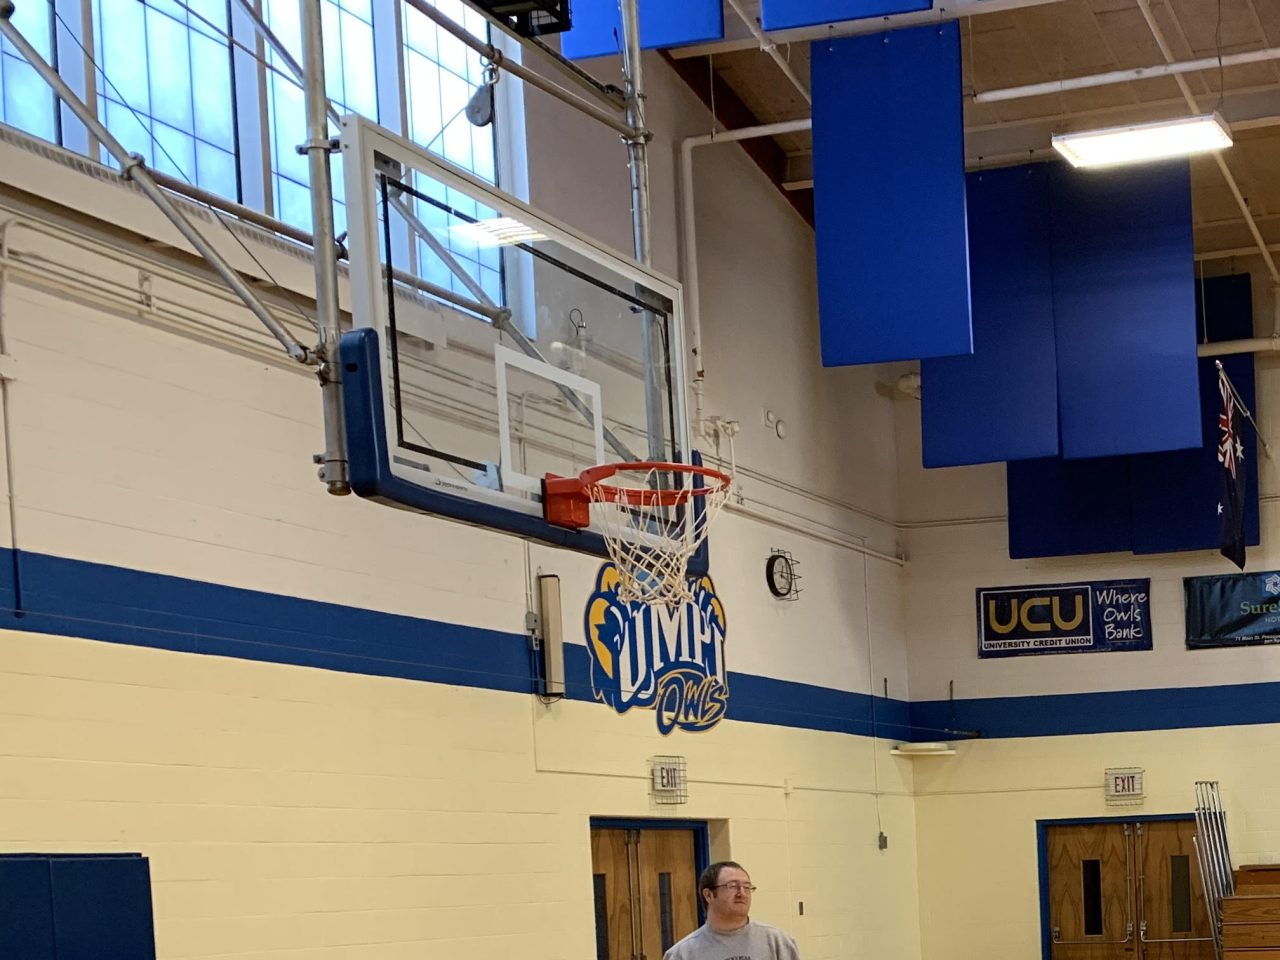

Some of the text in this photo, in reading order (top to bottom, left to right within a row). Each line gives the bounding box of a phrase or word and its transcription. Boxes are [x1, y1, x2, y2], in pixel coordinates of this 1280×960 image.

[1096, 589, 1147, 605] Where
[989, 594, 1083, 634] UCU
[1103, 605, 1141, 621] Owls
[1105, 624, 1143, 640] Bank
[984, 637, 1091, 649] UNIVERSITY CREDIT UNION
[660, 766, 677, 788] EXIT
[1114, 775, 1135, 793] EXIT
